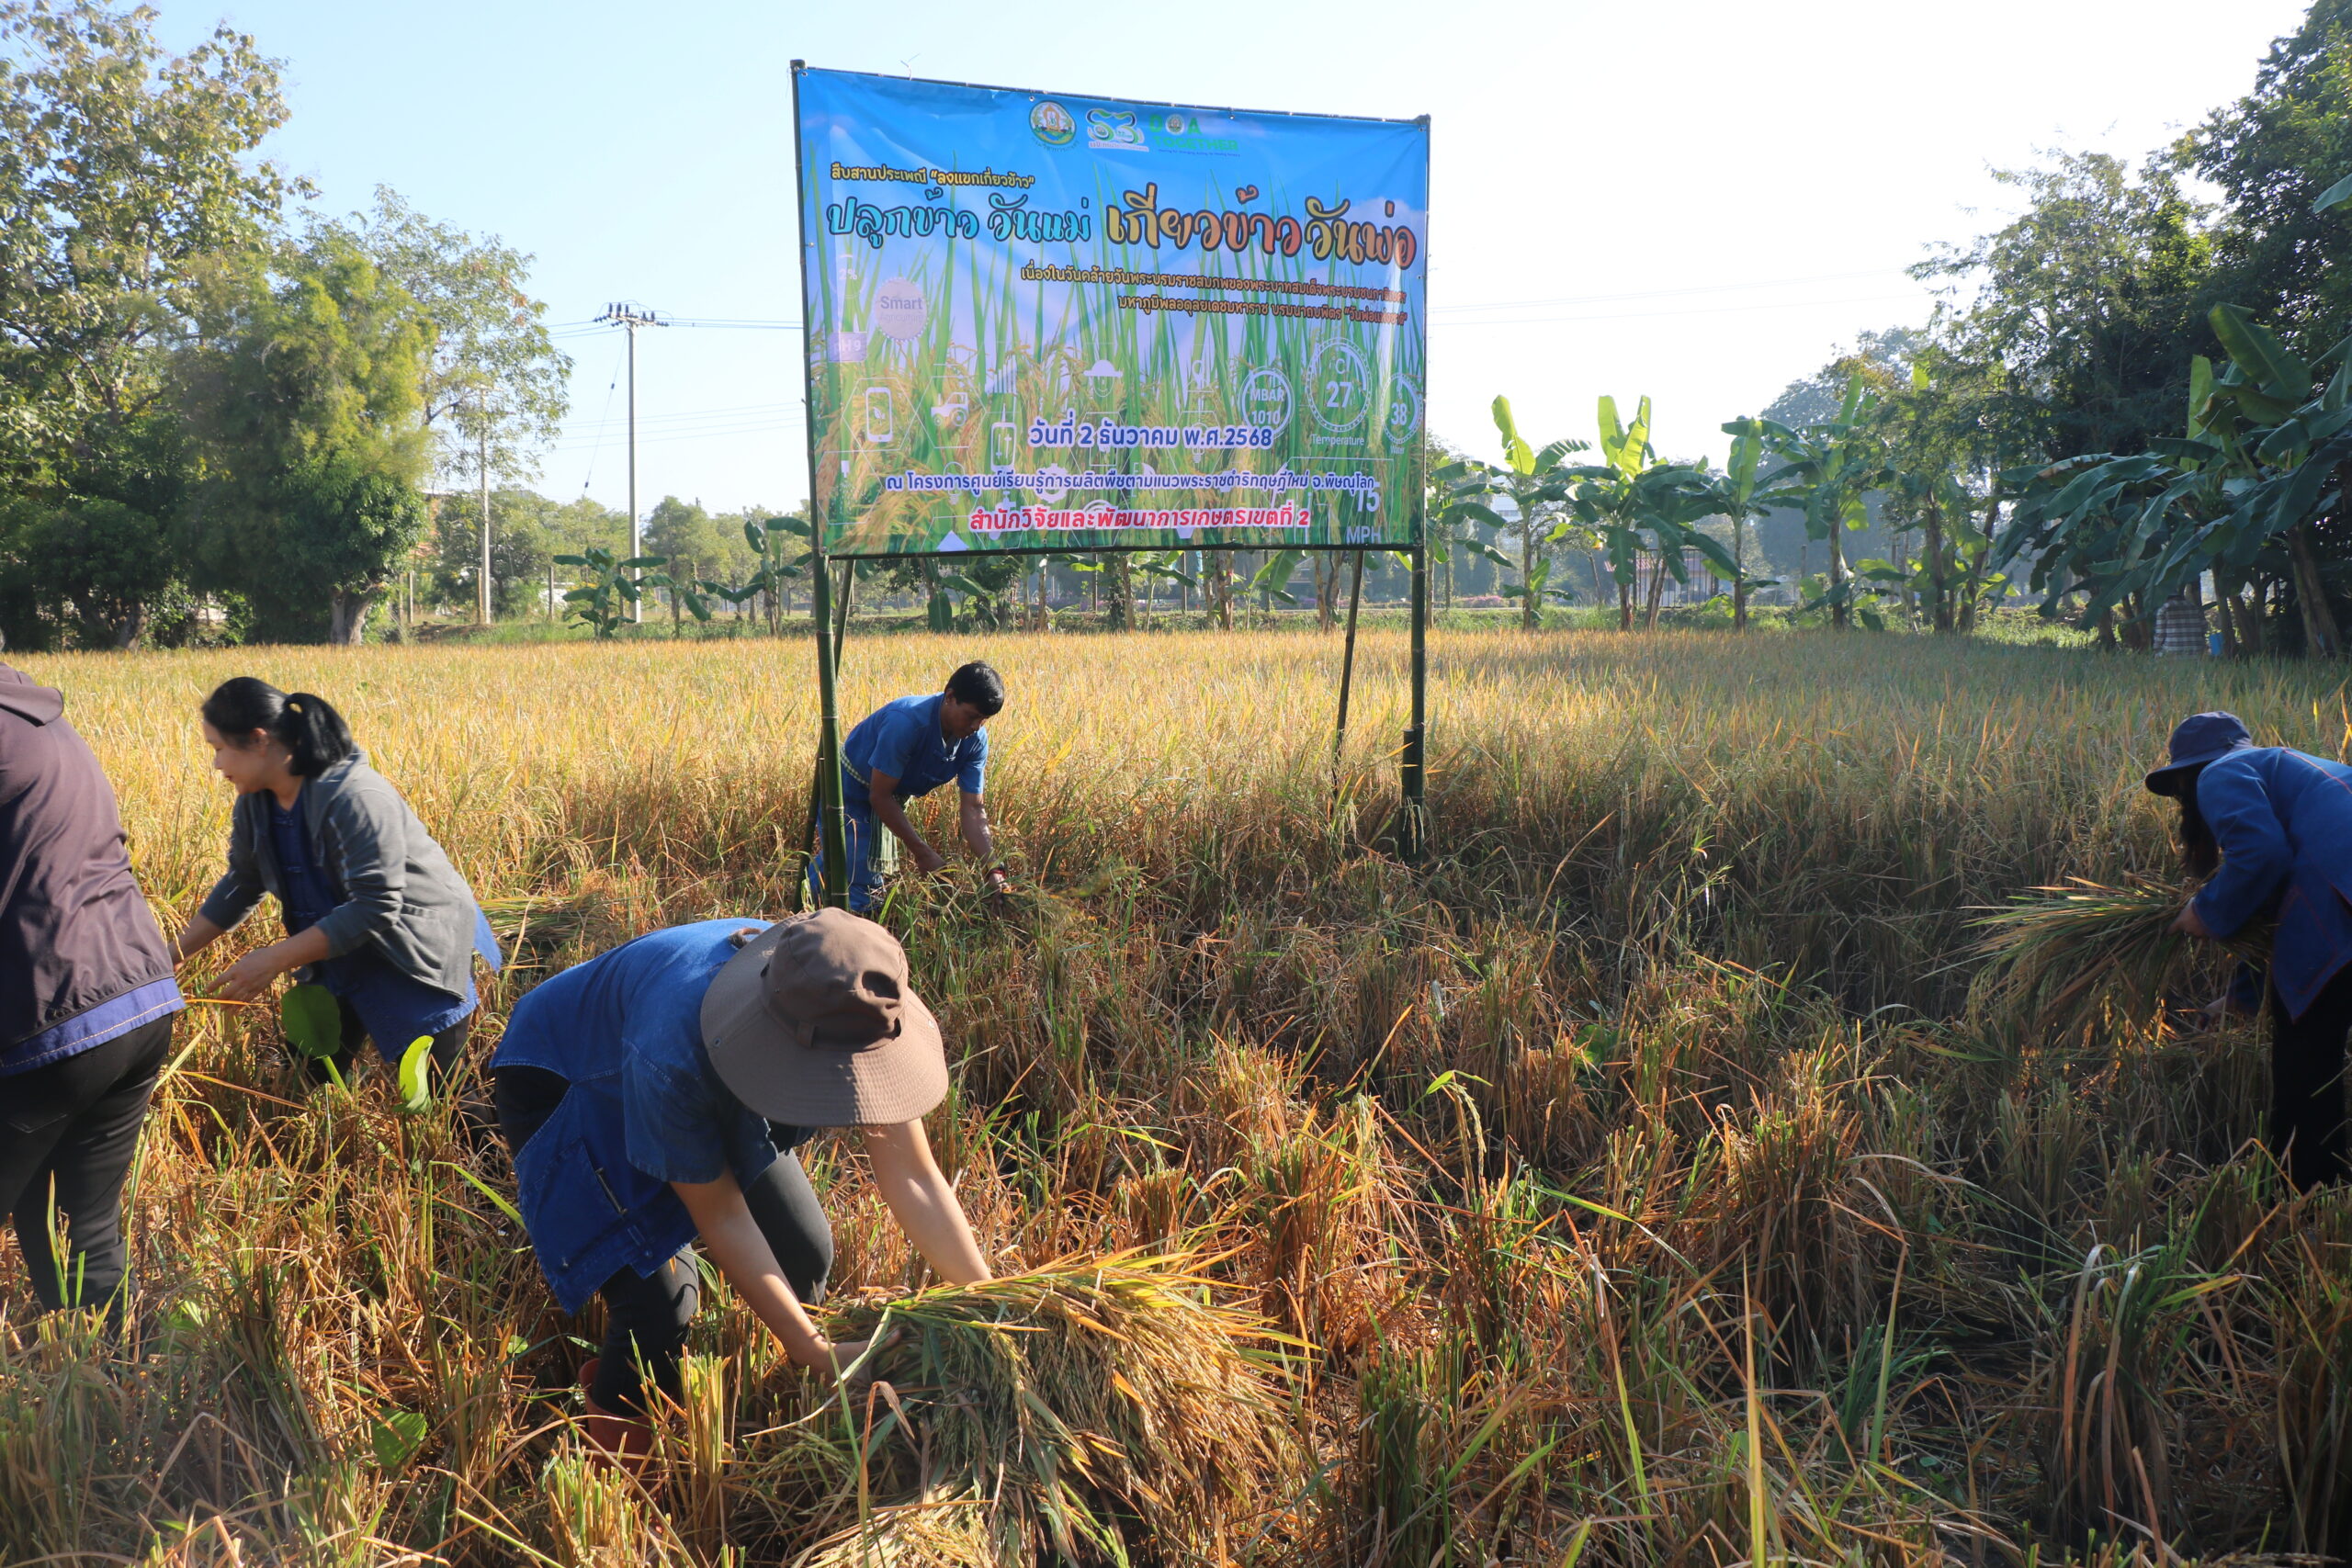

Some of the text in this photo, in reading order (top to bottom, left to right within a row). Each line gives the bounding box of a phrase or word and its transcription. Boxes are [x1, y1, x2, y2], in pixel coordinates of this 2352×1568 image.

[1153, 136, 1238, 151] TOGETHER
[831, 162, 928, 184] สืบสานประเพณี
[827, 186, 979, 249] ปลูกข้าว
[988, 192, 1091, 243] วันแม่
[880, 296, 923, 310] Smart
[1117, 294, 1269, 317] มหาภูมิพลอดุลยเดชมหาราช
[1272, 300, 1342, 321] บรมนาถบพิตร
[1250, 388, 1285, 401] MBAR
[1326, 381, 1353, 408] 27
[1251, 410, 1282, 424] 1010
[1391, 402, 1408, 425] 38
[1030, 411, 1273, 446] วันที่ 2 ธันวาคม พ.ศ.2568
[1311, 434, 1364, 446] Temperature
[886, 470, 1374, 495] ณ โครงการศูนย์เรียนรู้การผลิตพืชตามแนวพระราชดำริทฤษฎีใหม่ จ.พิษณุโลก
[970, 502, 1309, 530] สำนักวิจัยและพัฒนาการเกษตรเขตที่ 2
[1346, 525, 1382, 544] MPH
